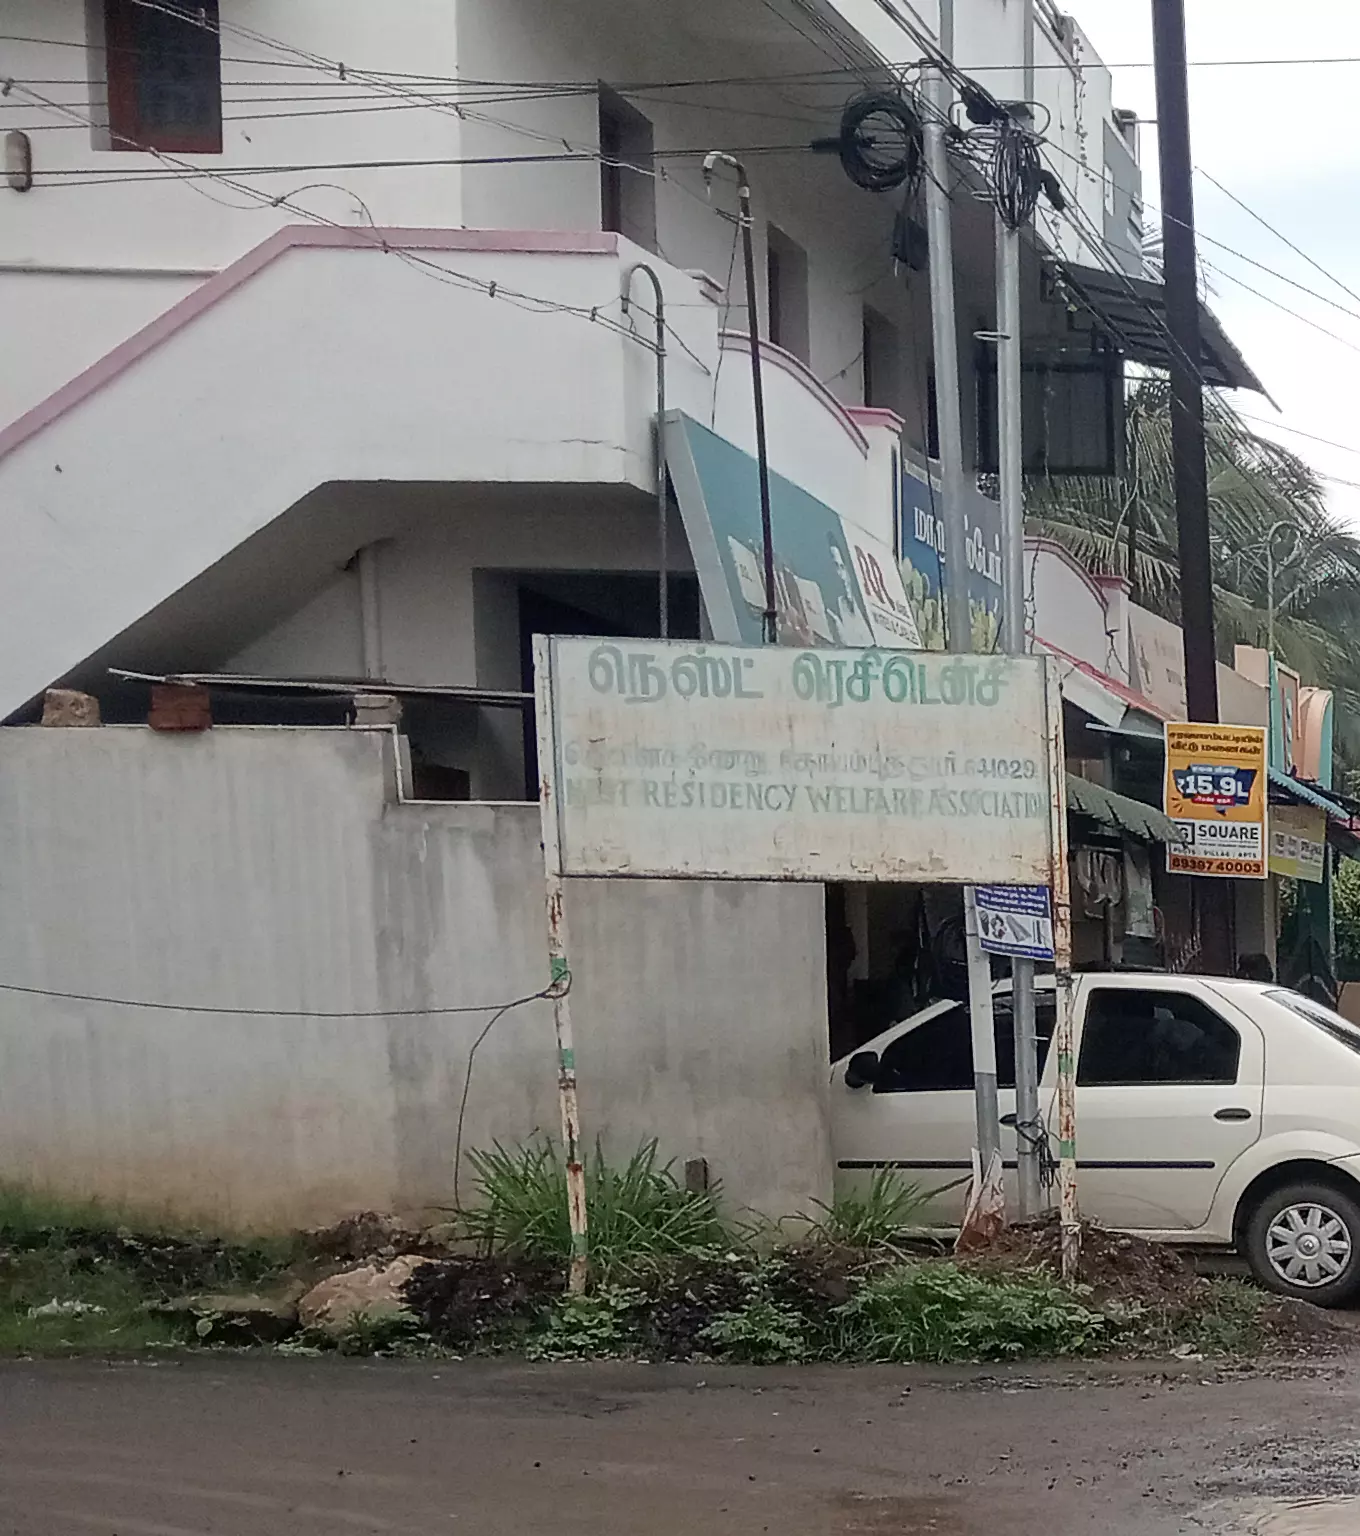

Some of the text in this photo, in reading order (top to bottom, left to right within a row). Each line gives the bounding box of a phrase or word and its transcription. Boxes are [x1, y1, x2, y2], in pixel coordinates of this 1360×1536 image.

[588, 644, 764, 703] நெஸ்ட்
[644, 779, 797, 813] RESIDENCY
[805, 784, 924, 818] WELFARE
[1198, 824, 1259, 841] SQUARE
[1216, 860, 1261, 873] 40003
